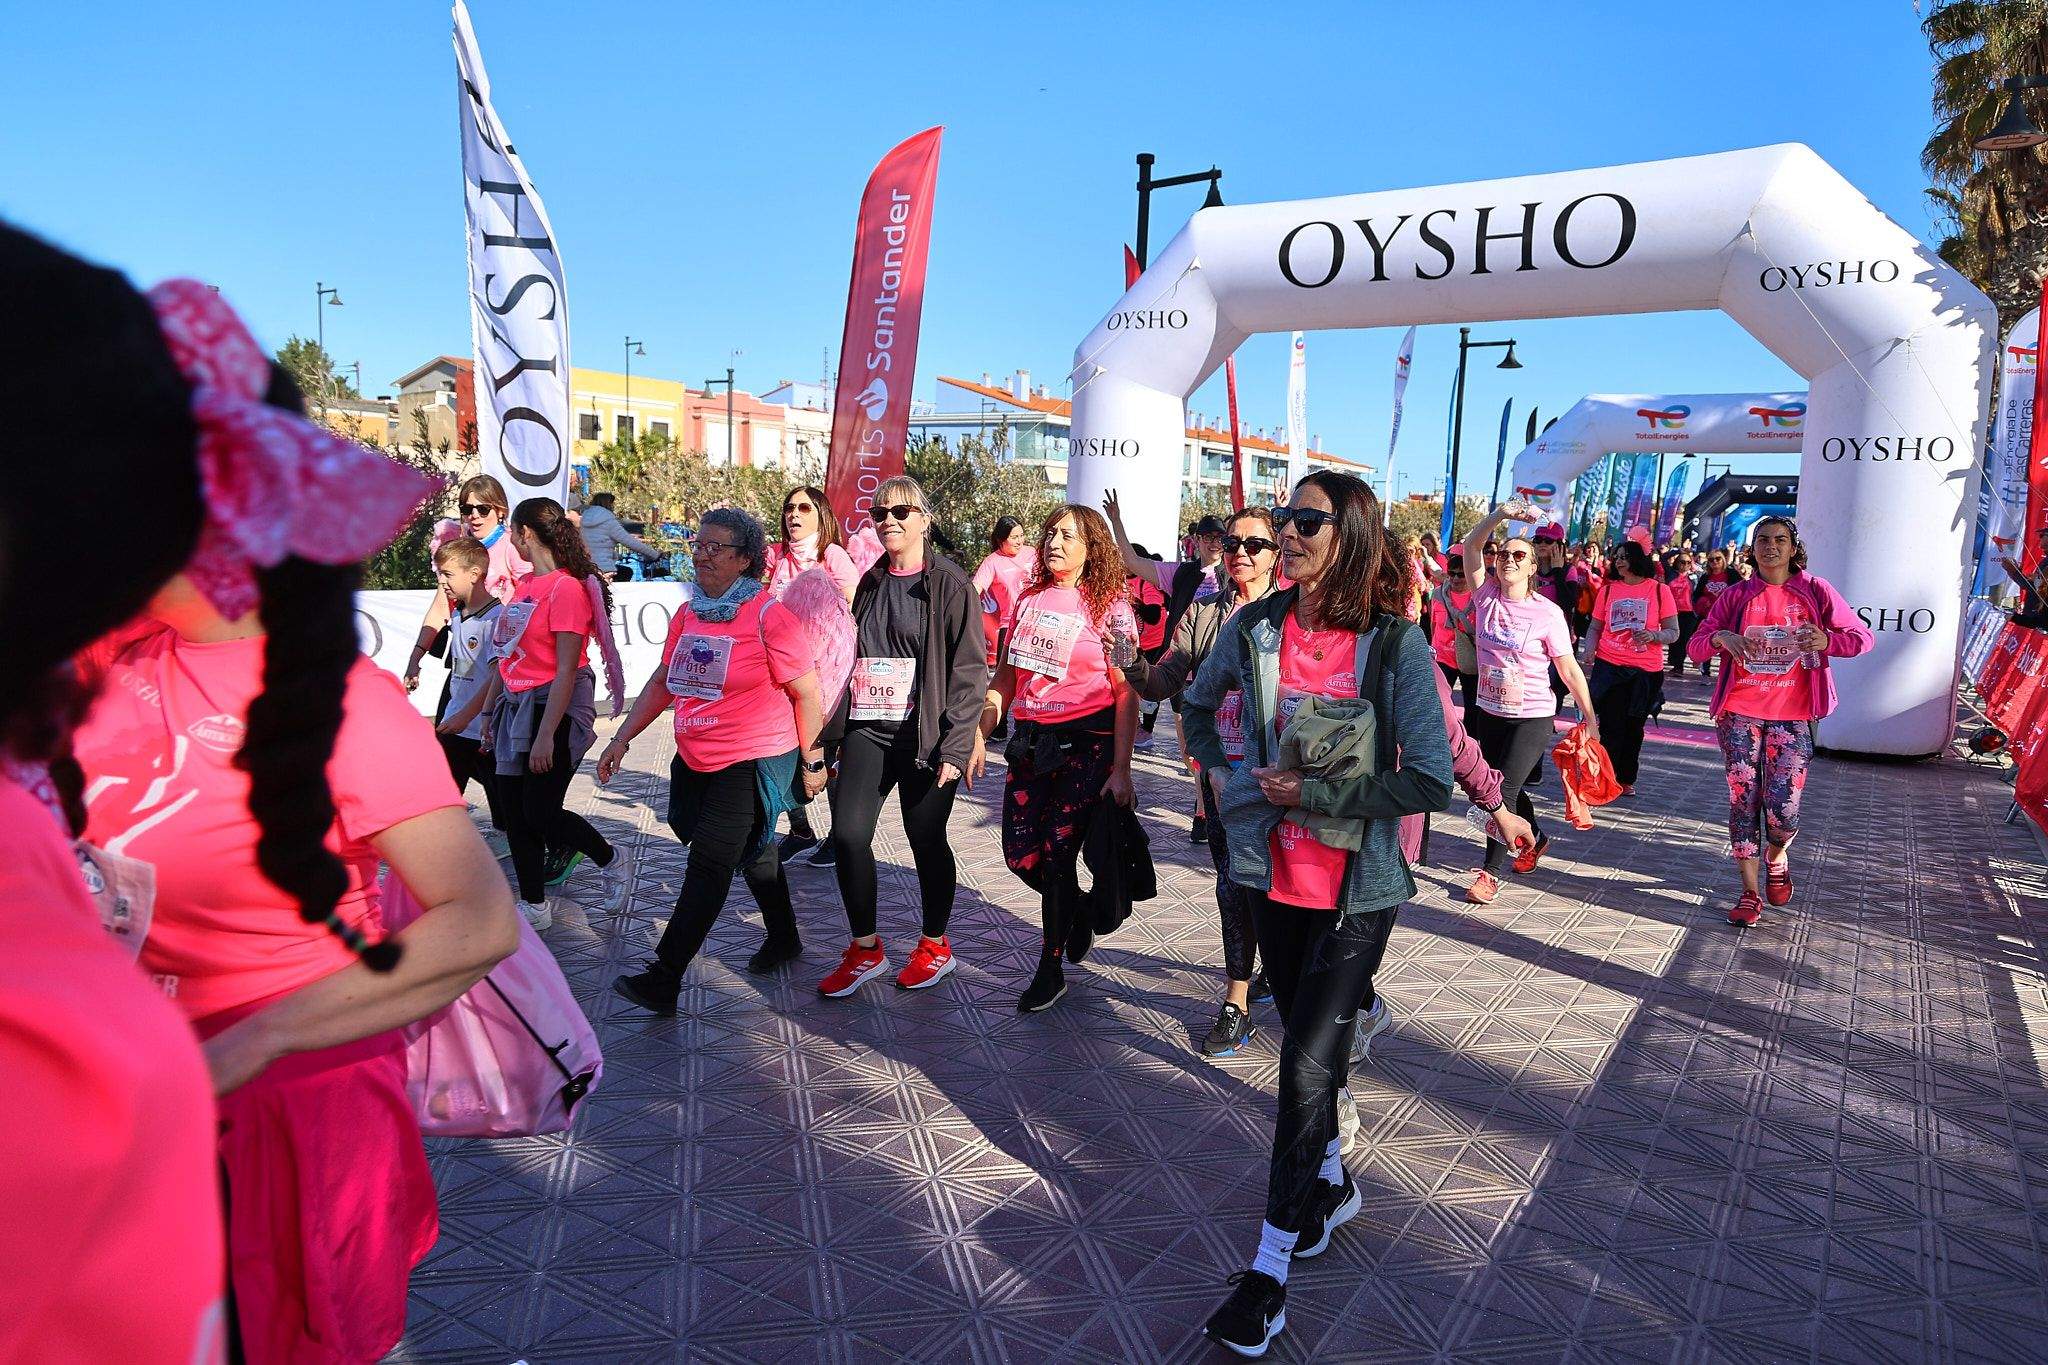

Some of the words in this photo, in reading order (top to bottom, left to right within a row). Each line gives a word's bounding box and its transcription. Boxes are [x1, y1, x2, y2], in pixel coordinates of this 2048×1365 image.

[1278, 193, 1637, 288] OYSHO
[867, 188, 911, 372] Santander
[1760, 260, 1900, 292] OYSHO
[1107, 309, 1188, 330] OYSHO
[1635, 432, 1689, 440] TotalEnergies
[1069, 438, 1140, 458] OYSHO
[1822, 436, 1955, 462] OYSHO
[1608, 459, 1633, 528] Batiste
[1742, 484, 1798, 494] VOL
[1851, 606, 1936, 633] SHO
[1031, 635, 1054, 650] 016
[1765, 646, 1788, 655] 016
[687, 662, 707, 675] 016
[870, 686, 894, 696] 016
[1489, 685, 1507, 696] 016
[693, 716, 719, 726] MUJER
[1278, 823, 1289, 837] DE
[1291, 826, 1304, 839] LA
